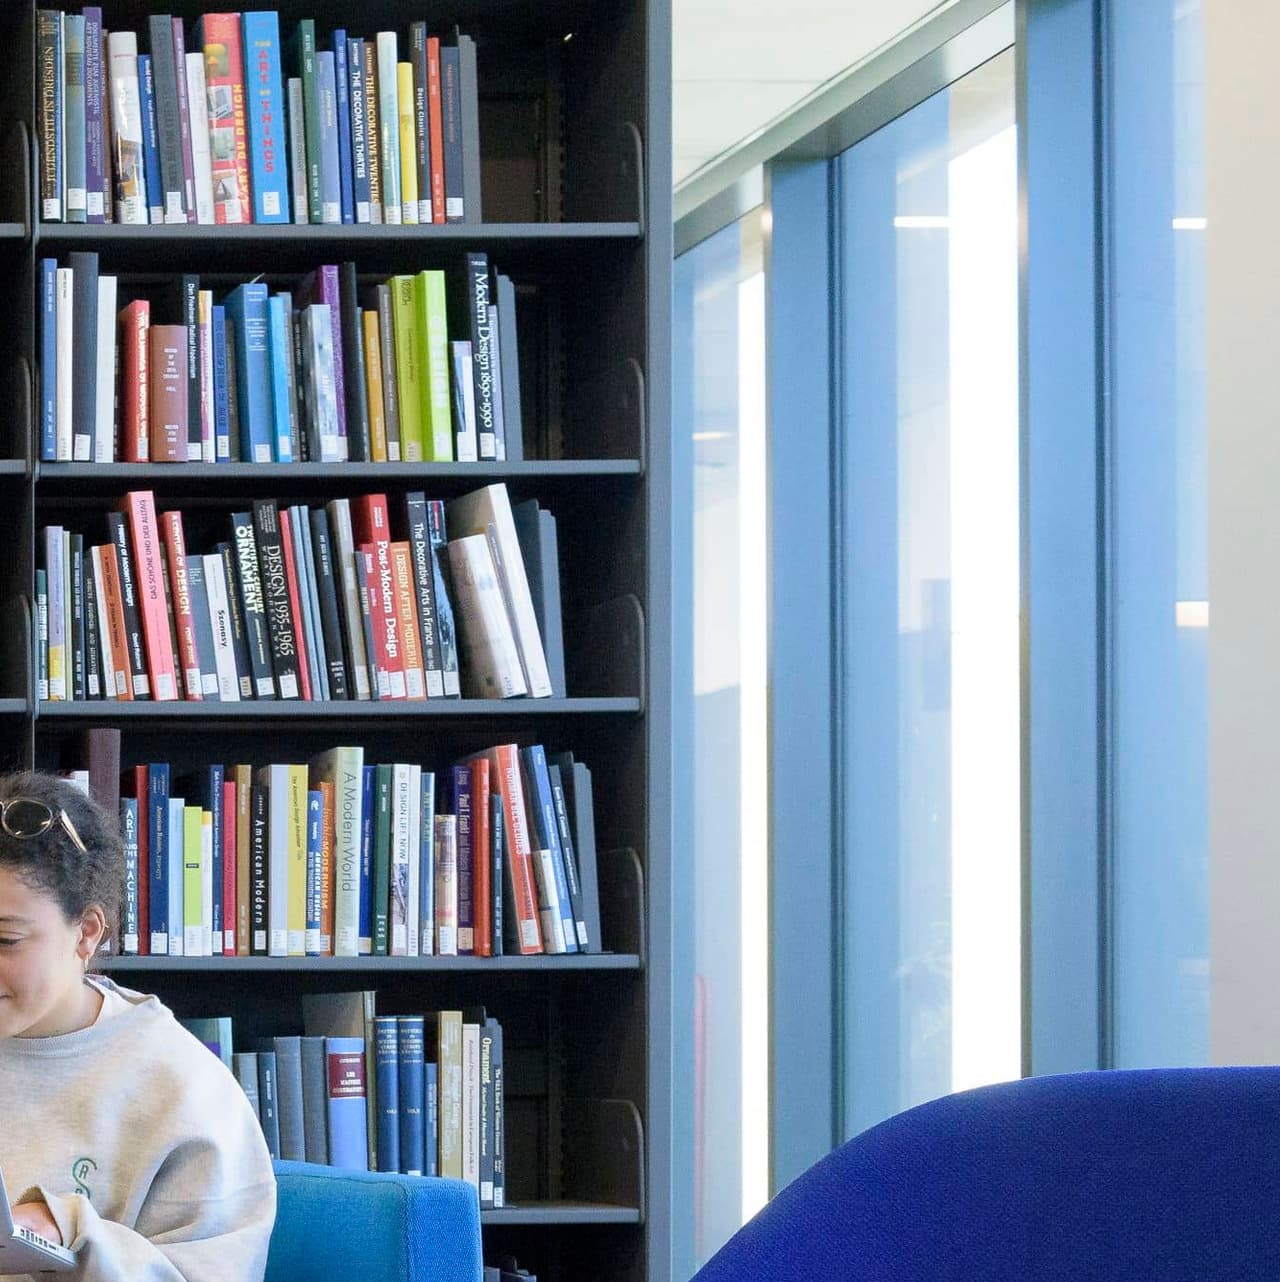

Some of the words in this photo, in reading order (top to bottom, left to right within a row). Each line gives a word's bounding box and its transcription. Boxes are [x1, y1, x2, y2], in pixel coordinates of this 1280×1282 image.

[352, 71, 361, 87] THE
[366, 76, 375, 94] THE
[354, 90, 363, 142] DECORATIVE
[366, 96, 377, 156] DECORATIVE
[356, 144, 365, 178] THIRTIES
[369, 157, 379, 202] TWENTIES
[474, 273, 488, 323] Modern
[474, 326, 490, 370] Design
[479, 372, 493, 428] 1890-1990
[415, 523, 424, 538] The
[237, 526, 257, 612] ORNAMENT
[267, 545, 284, 596] DESIGN
[415, 541, 427, 585] Decorative
[377, 541, 394, 613] Post-Modern
[386, 618, 397, 657] Design
[420, 588, 430, 605] Arts
[218, 610, 228, 647] Szenasy
[272, 600, 294, 656] 1935-1965
[424, 618, 434, 645] France
[344, 772, 356, 783] A
[344, 787, 356, 844] Modern
[255, 820, 264, 875] American
[343, 850, 356, 892] World
[256, 880, 265, 923] Modern
[483, 1038, 491, 1084] Ornament
